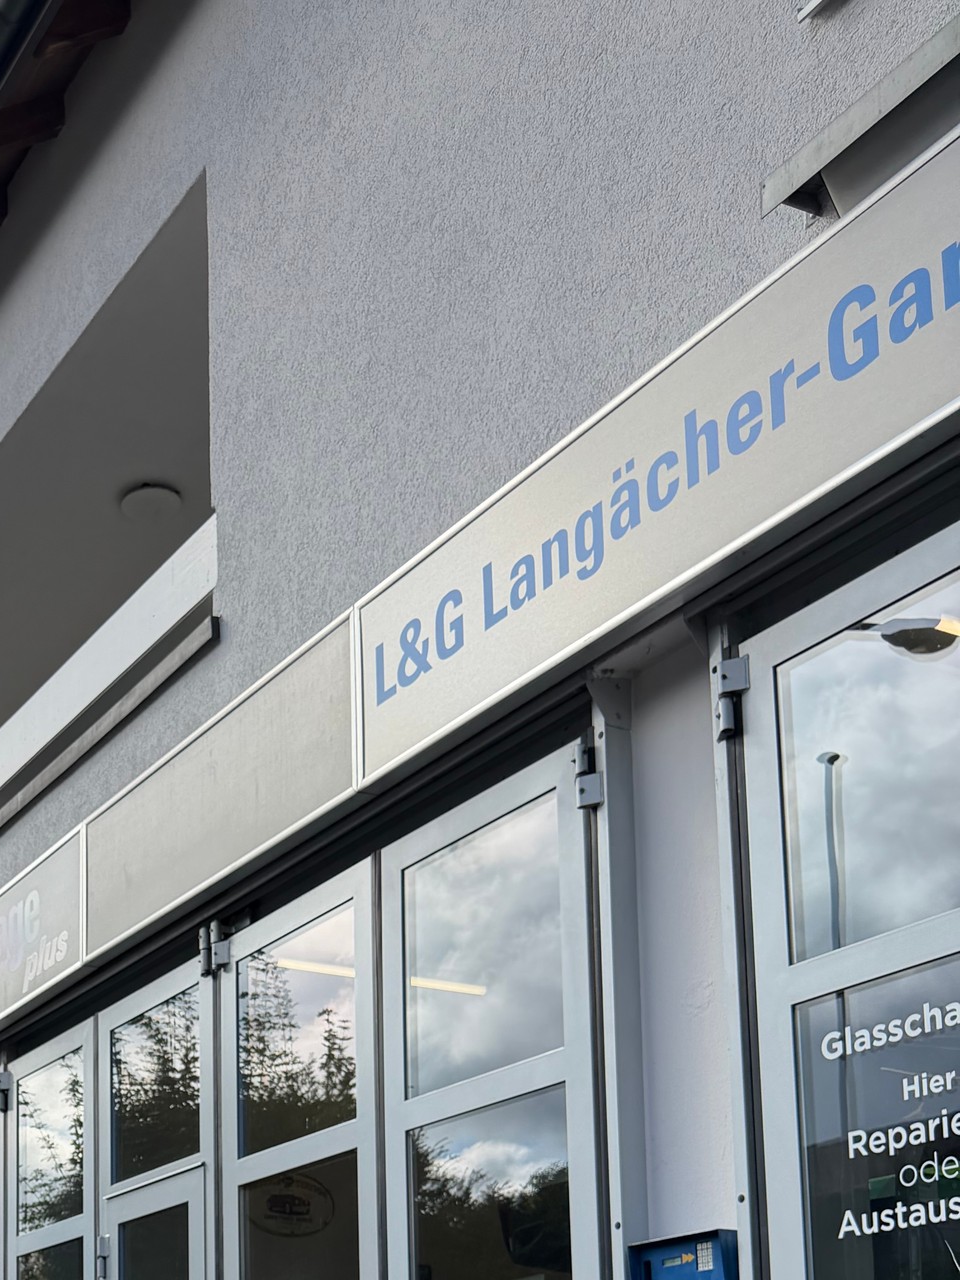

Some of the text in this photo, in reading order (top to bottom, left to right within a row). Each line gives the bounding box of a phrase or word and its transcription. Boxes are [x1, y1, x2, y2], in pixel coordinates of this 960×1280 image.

[375, 589, 466, 707] L&G
[22, 930, 69, 994] plus
[821, 1001, 960, 1060] Glasscha
[902, 1070, 956, 1101] Hier
[899, 1151, 960, 1187] ode
[838, 1196, 960, 1239] Austaus
